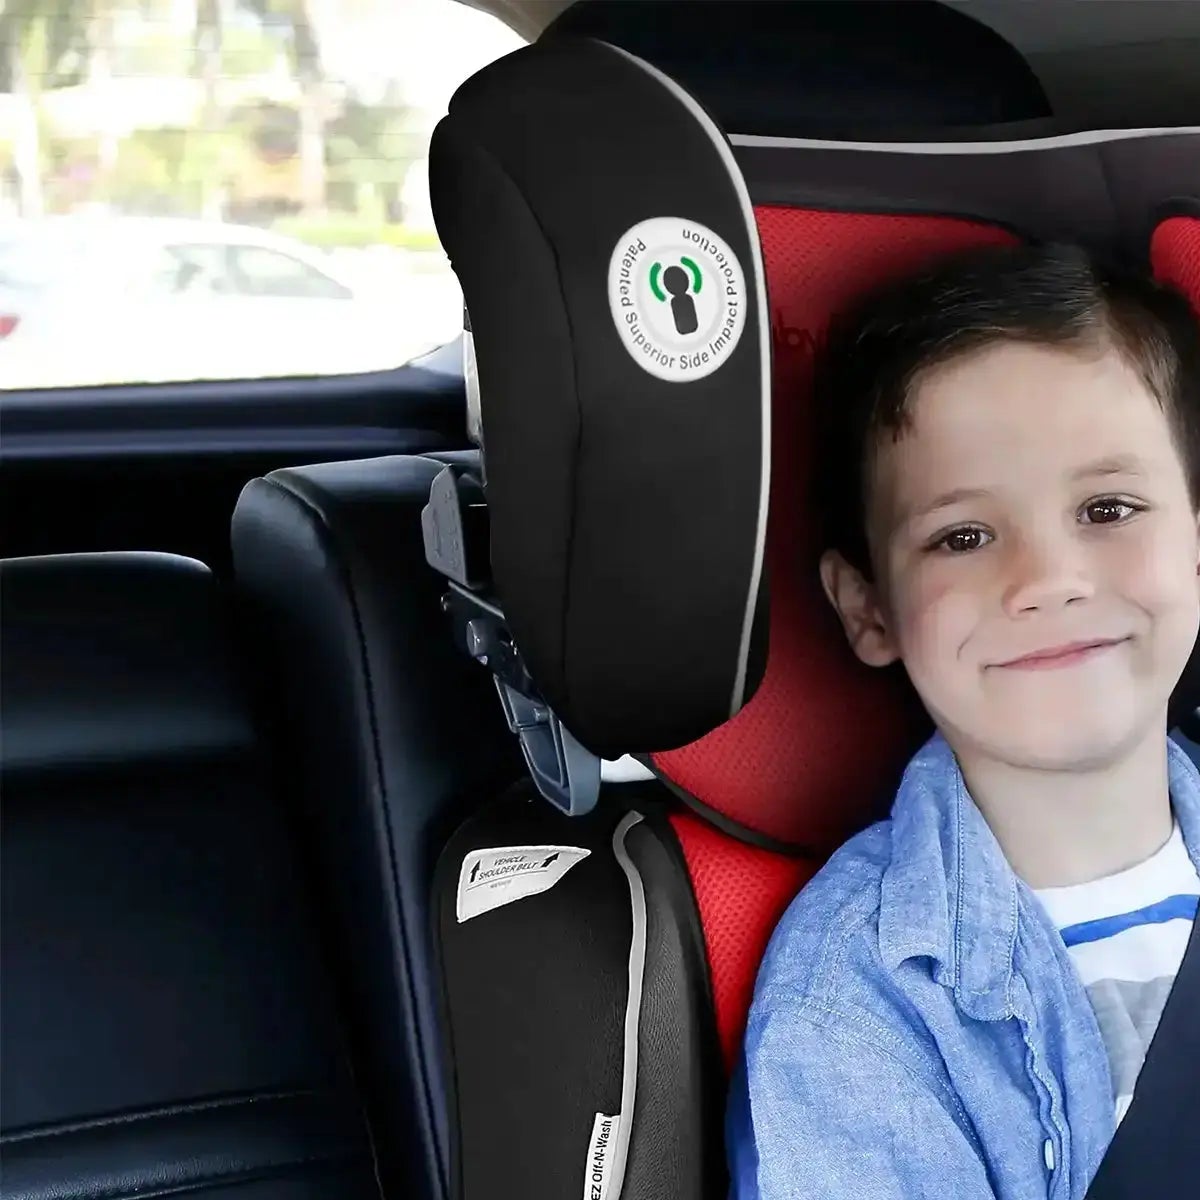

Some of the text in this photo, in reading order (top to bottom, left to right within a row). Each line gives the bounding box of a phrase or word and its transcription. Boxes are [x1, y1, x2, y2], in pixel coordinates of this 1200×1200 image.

[619, 228, 739, 370] Patented Superior Side Impact Protection
[478, 860, 540, 881] SHOULDER BELT
[592, 1119, 613, 1183] Off-N-Wash
